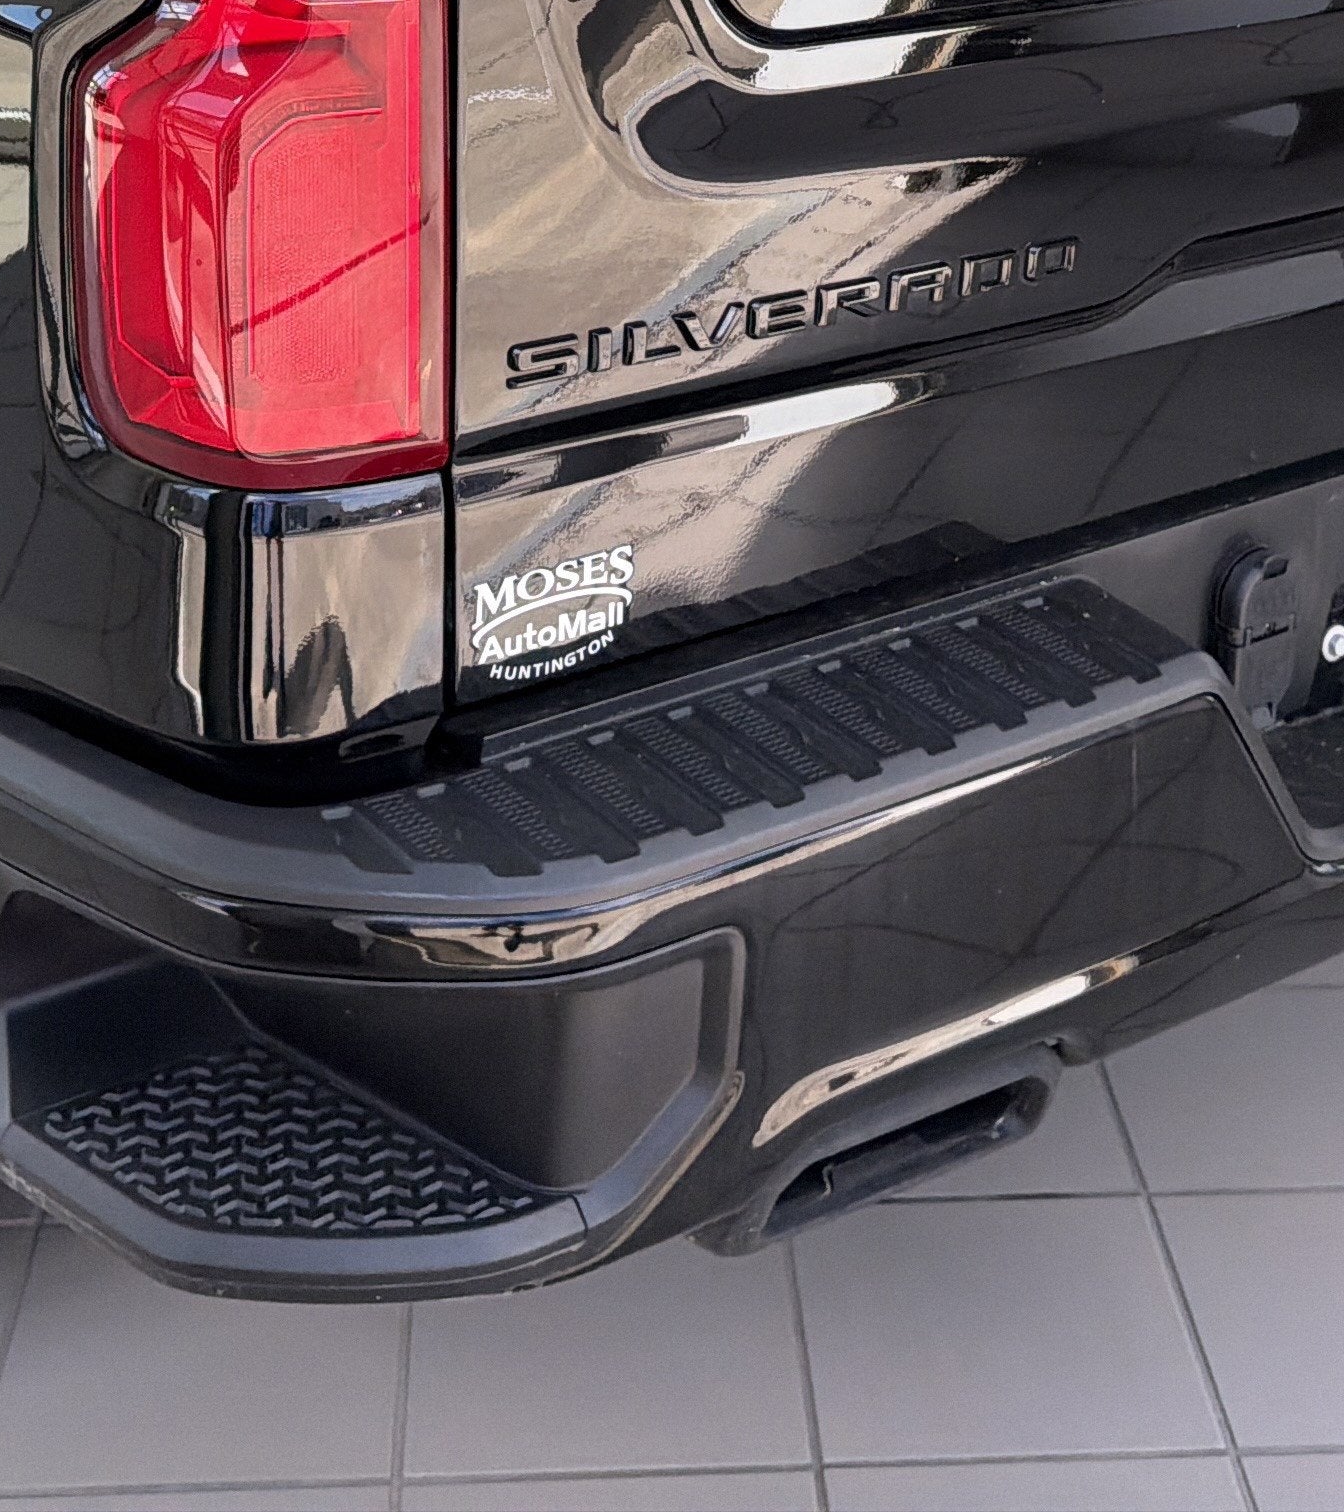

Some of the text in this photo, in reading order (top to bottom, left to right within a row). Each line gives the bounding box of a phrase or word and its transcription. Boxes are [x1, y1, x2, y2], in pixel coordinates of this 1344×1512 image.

[506, 235, 1079, 390] SILVERADO
[472, 545, 634, 631] MOSES
[478, 601, 624, 665] AutoMall
[489, 629, 615, 681] HUNTINGTON
